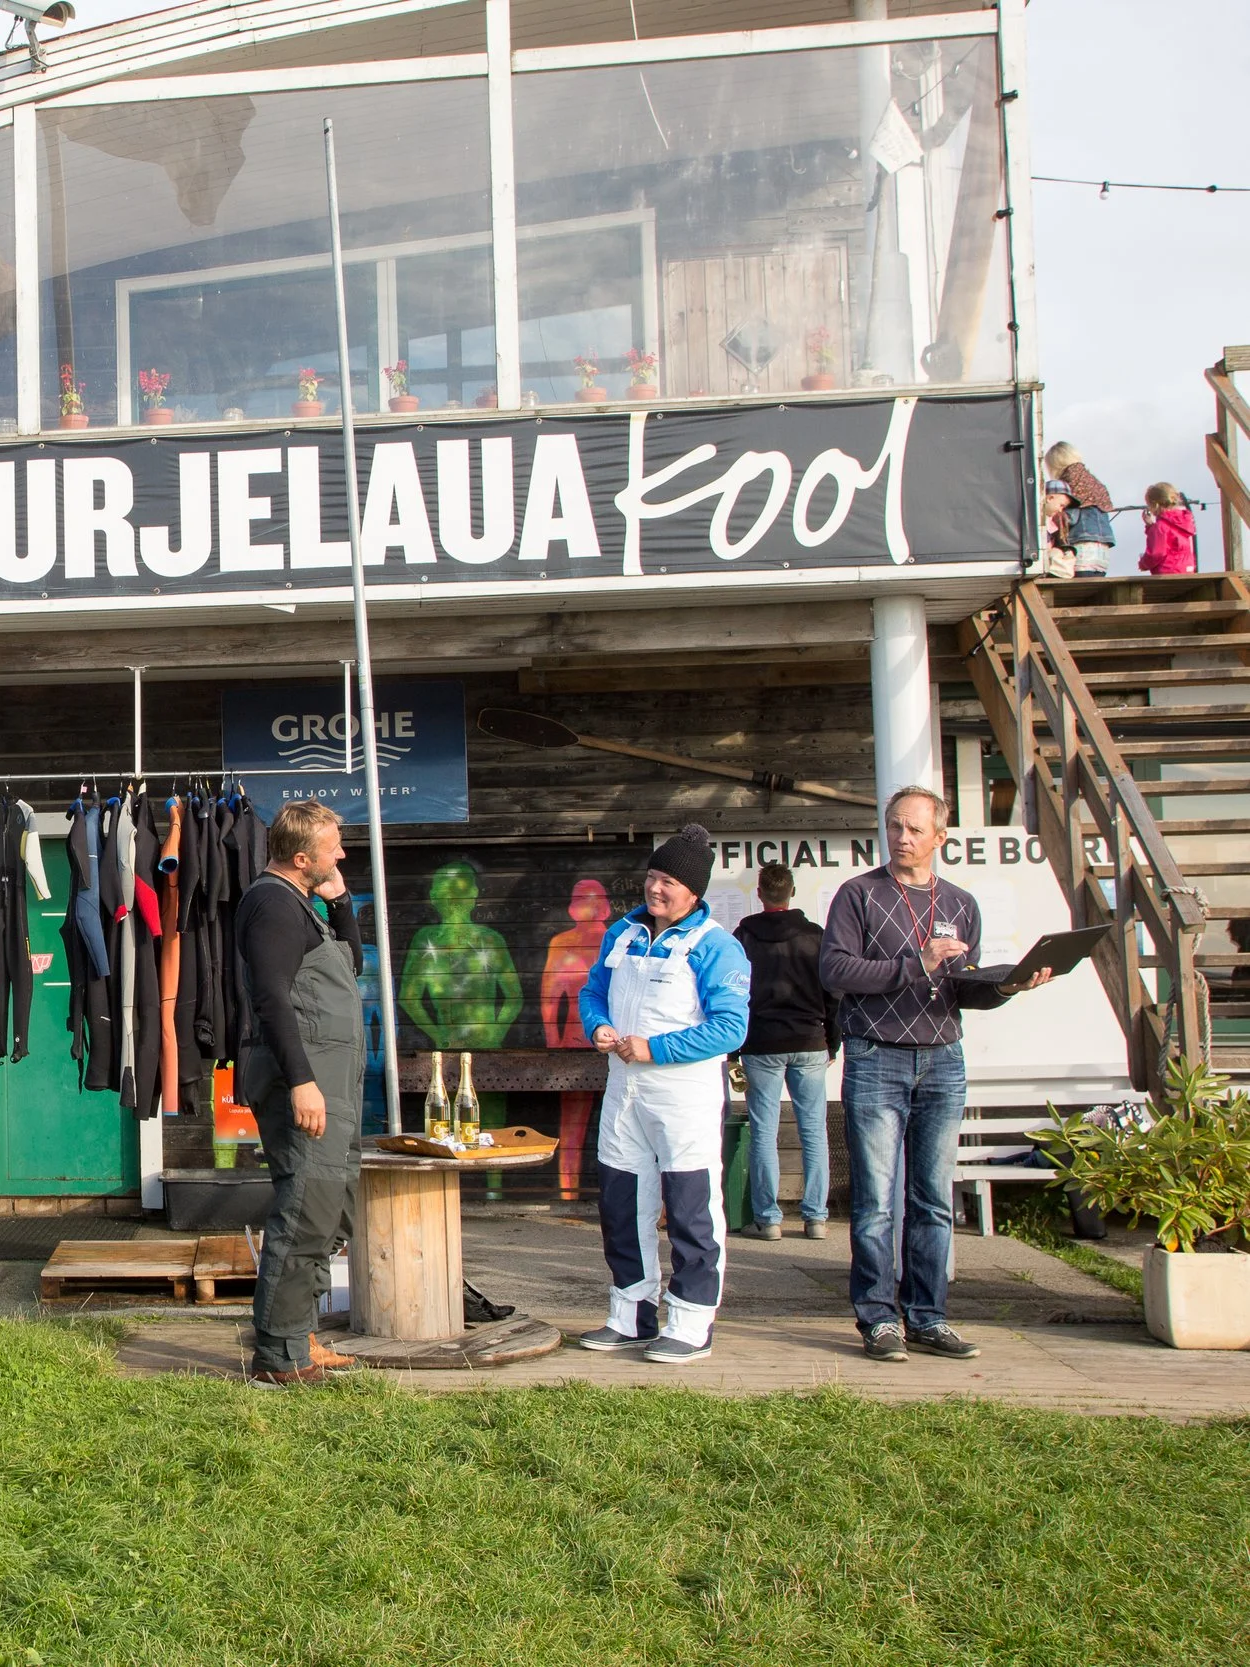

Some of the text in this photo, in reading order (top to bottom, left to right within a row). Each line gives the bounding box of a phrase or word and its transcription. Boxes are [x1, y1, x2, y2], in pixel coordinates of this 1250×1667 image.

[271, 711, 416, 742] GROHE
[282, 789, 340, 799] ENJOY
[708, 841, 839, 868] FICIAL
